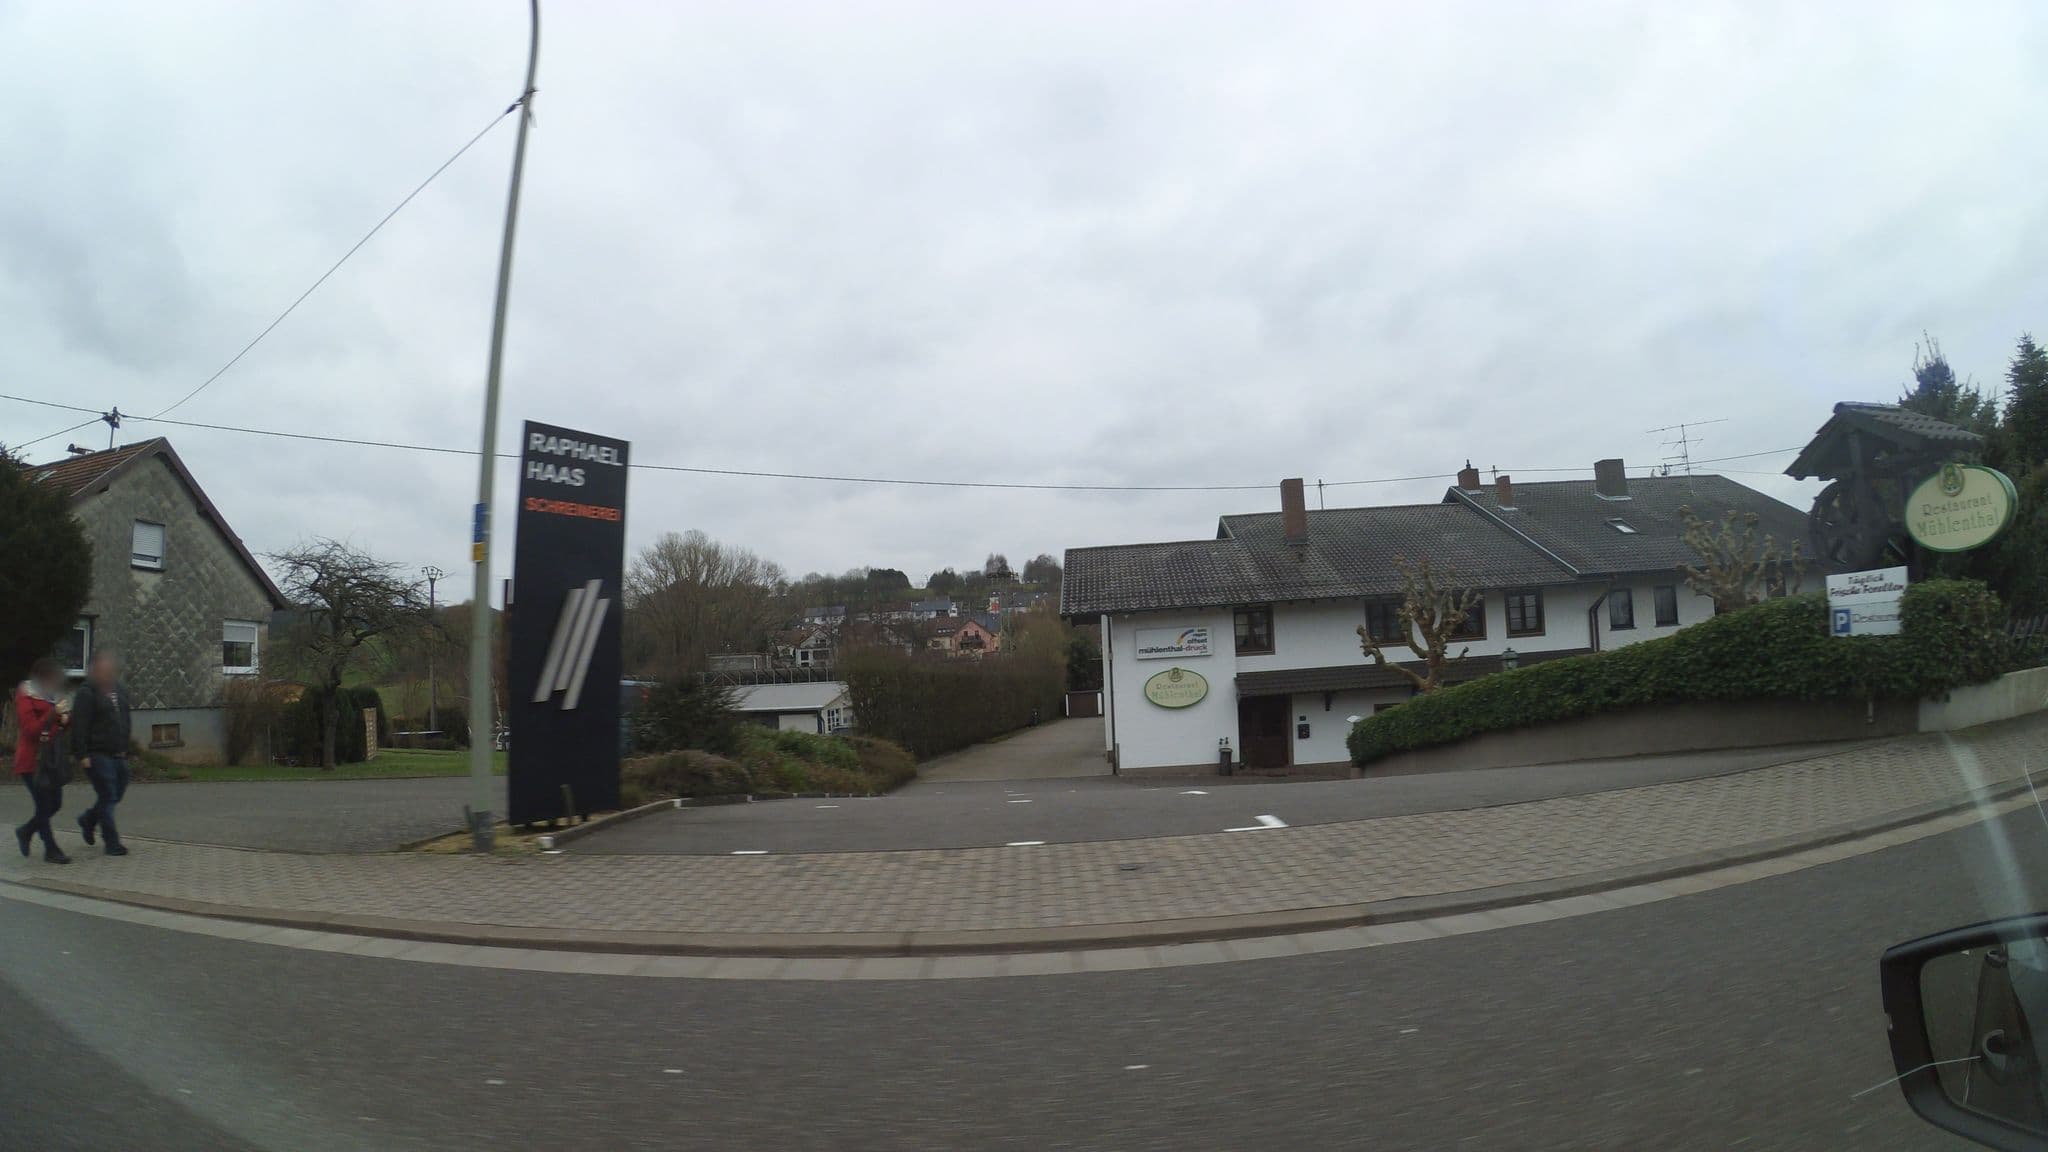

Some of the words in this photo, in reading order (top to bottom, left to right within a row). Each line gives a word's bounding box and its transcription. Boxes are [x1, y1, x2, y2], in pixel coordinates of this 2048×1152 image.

[529, 432, 623, 466] RAPHAEL
[527, 461, 585, 486] HAAS
[526, 497, 621, 520] SCHREINEREI
[1920, 493, 1992, 516] Restaurant
[1918, 507, 1999, 537] Mühlenthal
